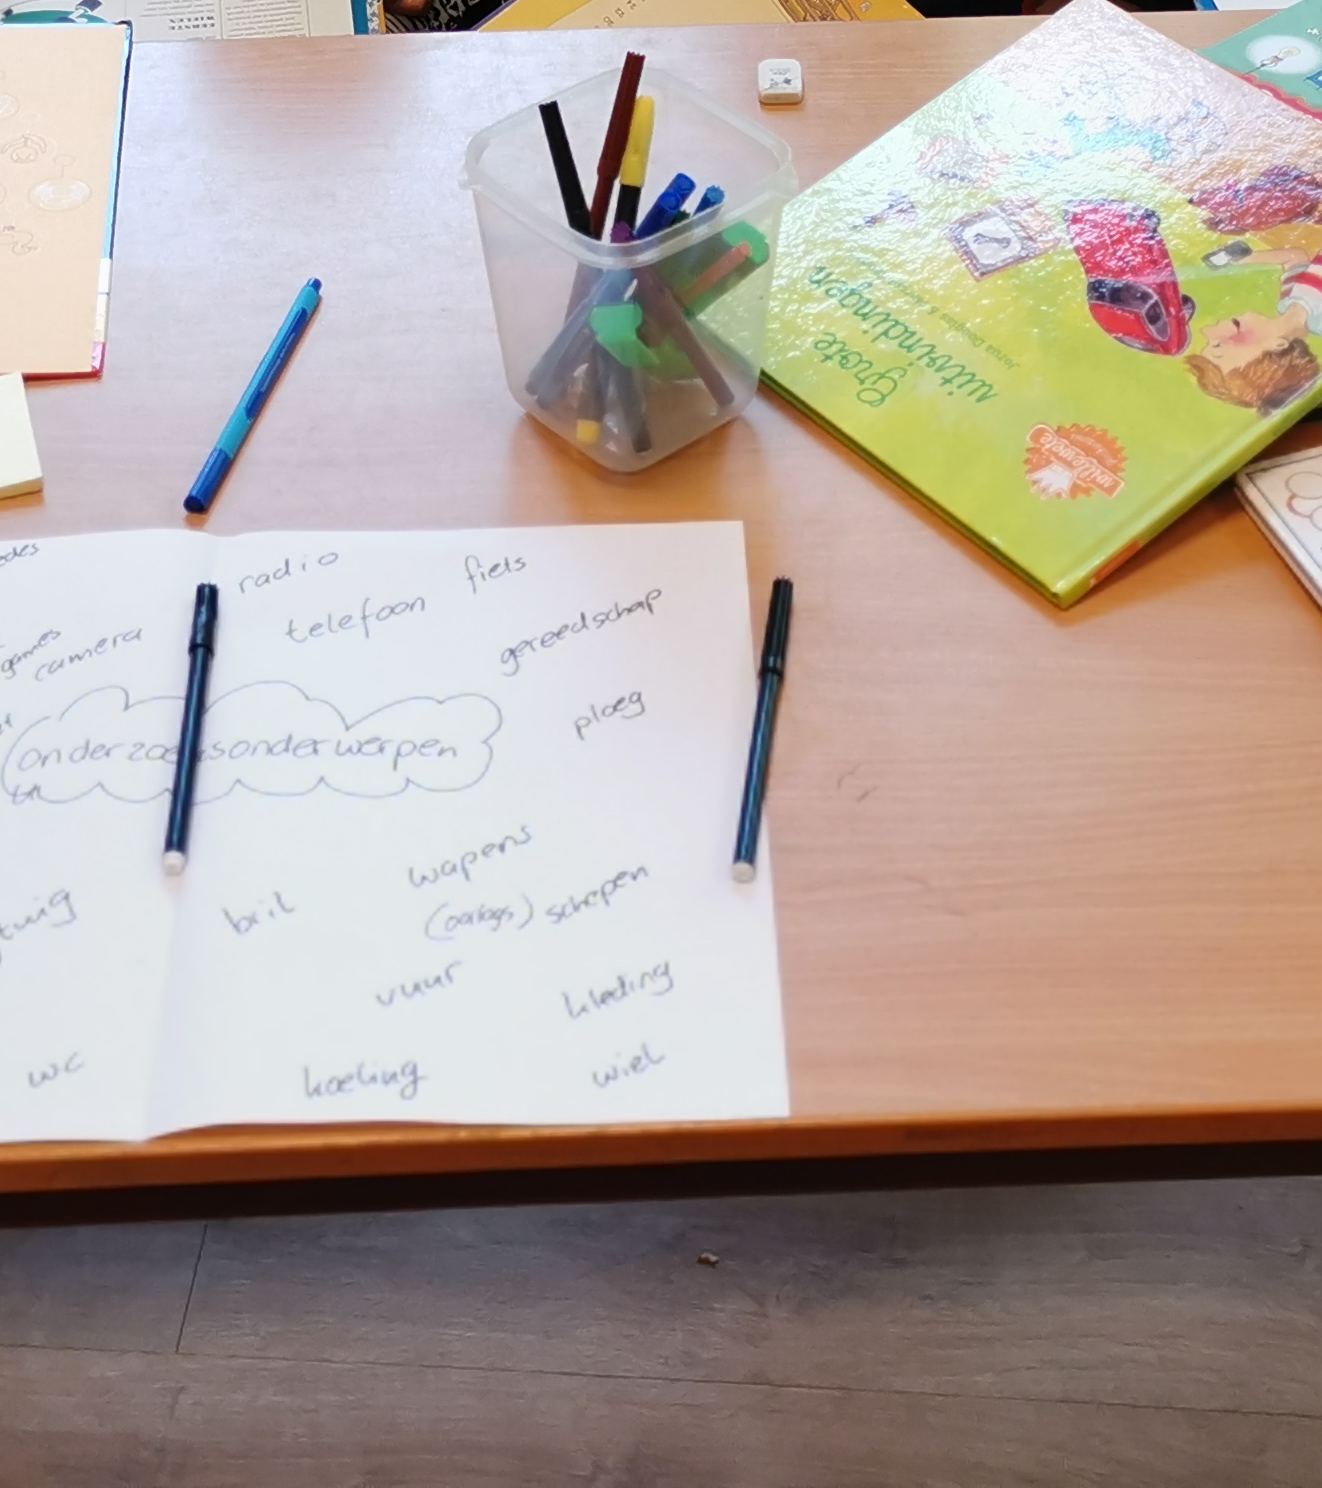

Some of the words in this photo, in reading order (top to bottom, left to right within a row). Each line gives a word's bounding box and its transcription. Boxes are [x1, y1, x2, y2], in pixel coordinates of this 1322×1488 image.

[807, 266, 999, 404] uitvindingen
[813, 332, 909, 408] Grote
[237, 552, 340, 594] radio
[463, 552, 528, 594] fiets
[285, 594, 427, 644] telefoon
[500, 587, 663, 677] gereedschap
[0, 628, 62, 681] games
[34, 627, 145, 682] camera
[572, 689, 647, 741] ploeg
[407, 823, 533, 888] wapens
[376, 960, 466, 1008] vuur
[562, 960, 676, 1021] kleding
[25, 1051, 85, 1090] wc
[302, 1056, 430, 1102] koeling
[591, 1043, 666, 1089] wiel
